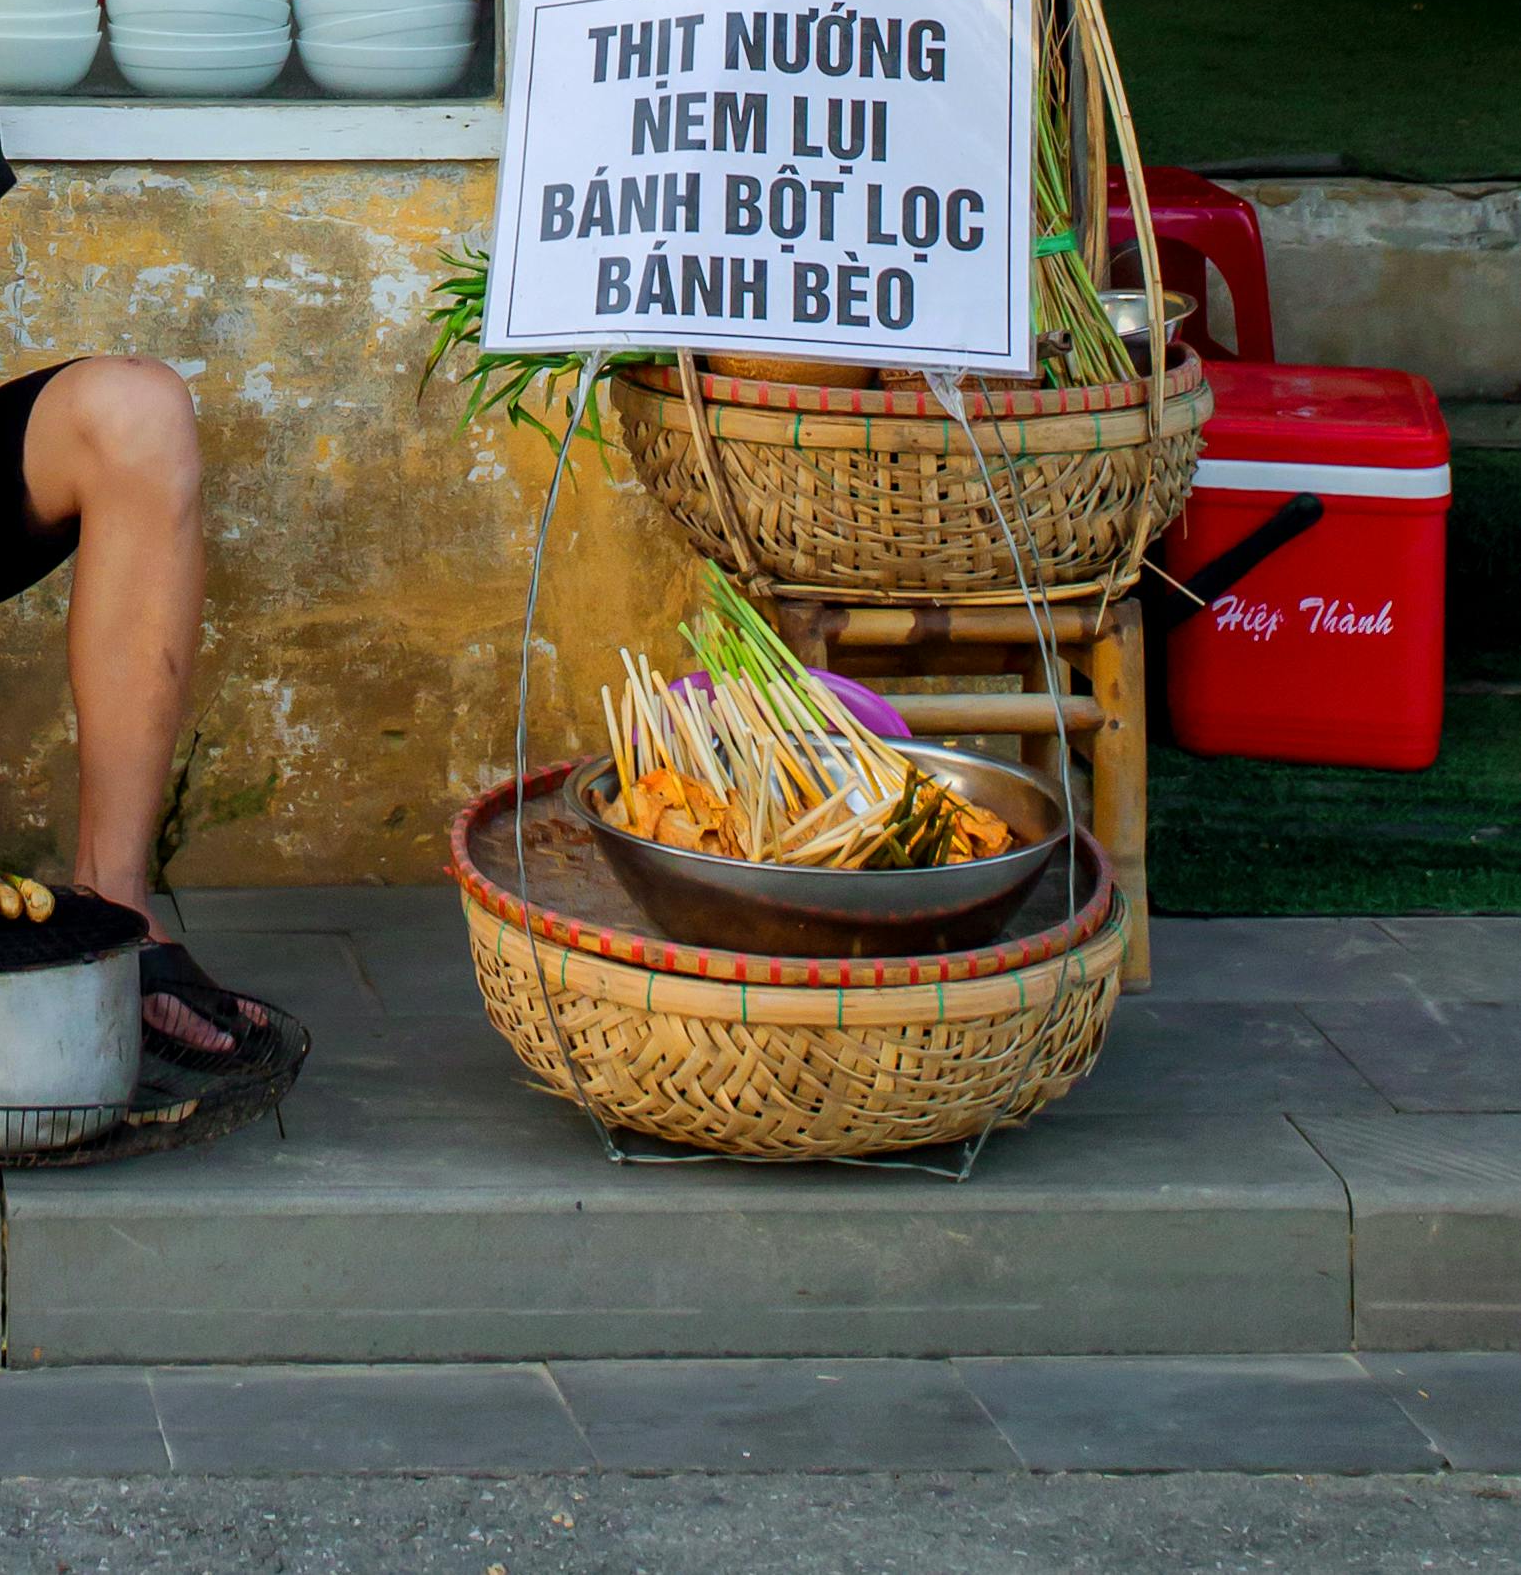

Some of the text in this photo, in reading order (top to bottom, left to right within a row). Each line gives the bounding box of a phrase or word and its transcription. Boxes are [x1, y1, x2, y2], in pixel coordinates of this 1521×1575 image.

[588, 2, 946, 90] THỊT NƯỚNG
[631, 91, 888, 175] NEM LỤI
[539, 164, 985, 263] BÁNH BỘT LỌC
[595, 240, 915, 331] BÁNH BÈO
[1299, 597, 1394, 636] Thành
